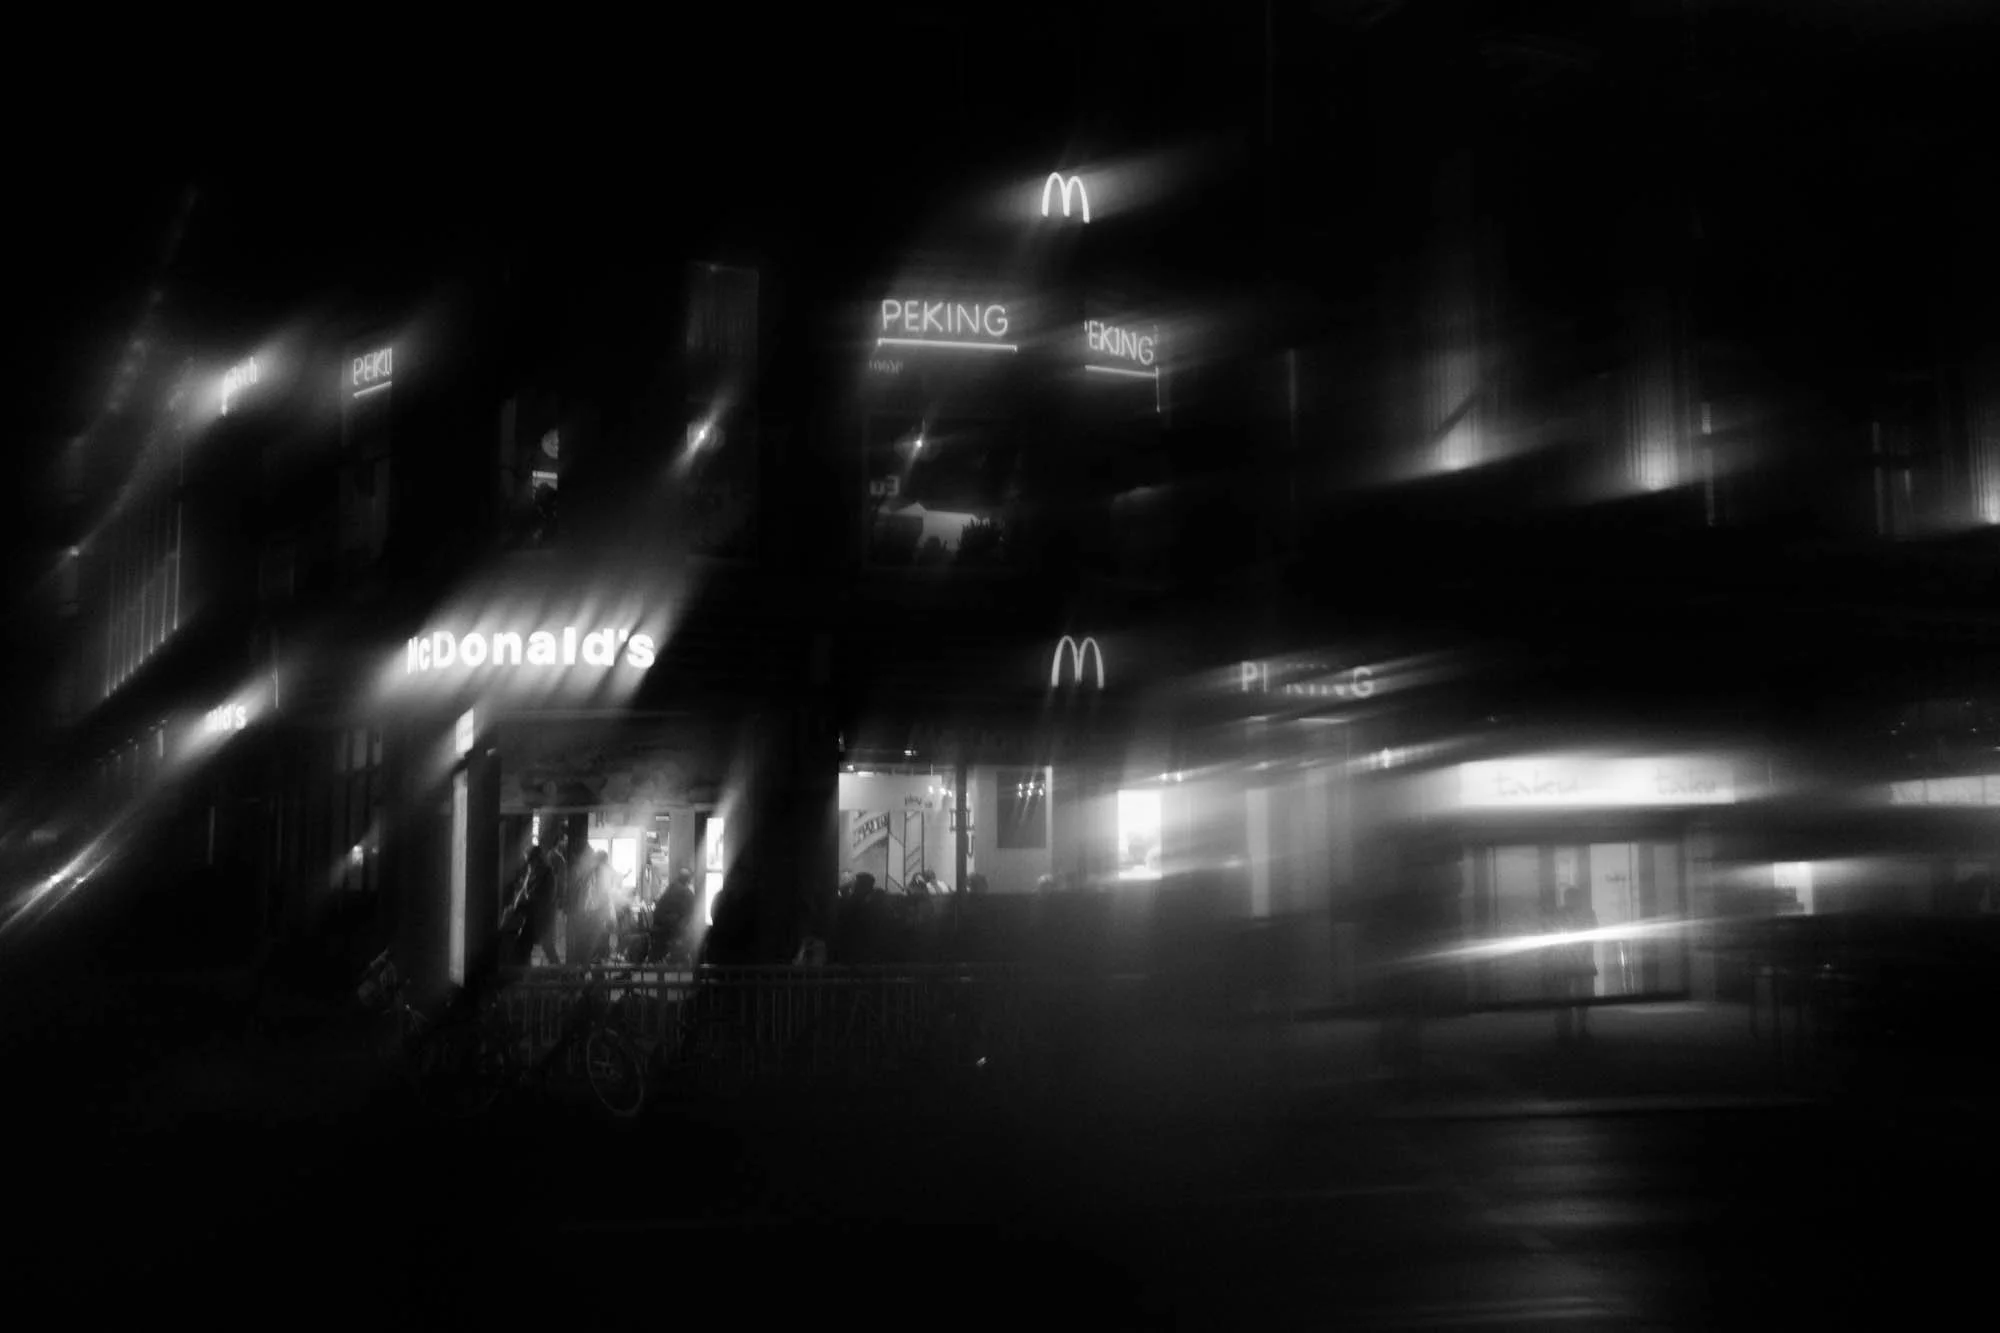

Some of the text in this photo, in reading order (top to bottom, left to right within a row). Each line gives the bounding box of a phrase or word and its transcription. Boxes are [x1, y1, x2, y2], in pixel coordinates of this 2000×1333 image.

[882, 299, 1008, 336] PEKING
[1085, 320, 1154, 365] EKING
[407, 626, 655, 674] McDonald's
